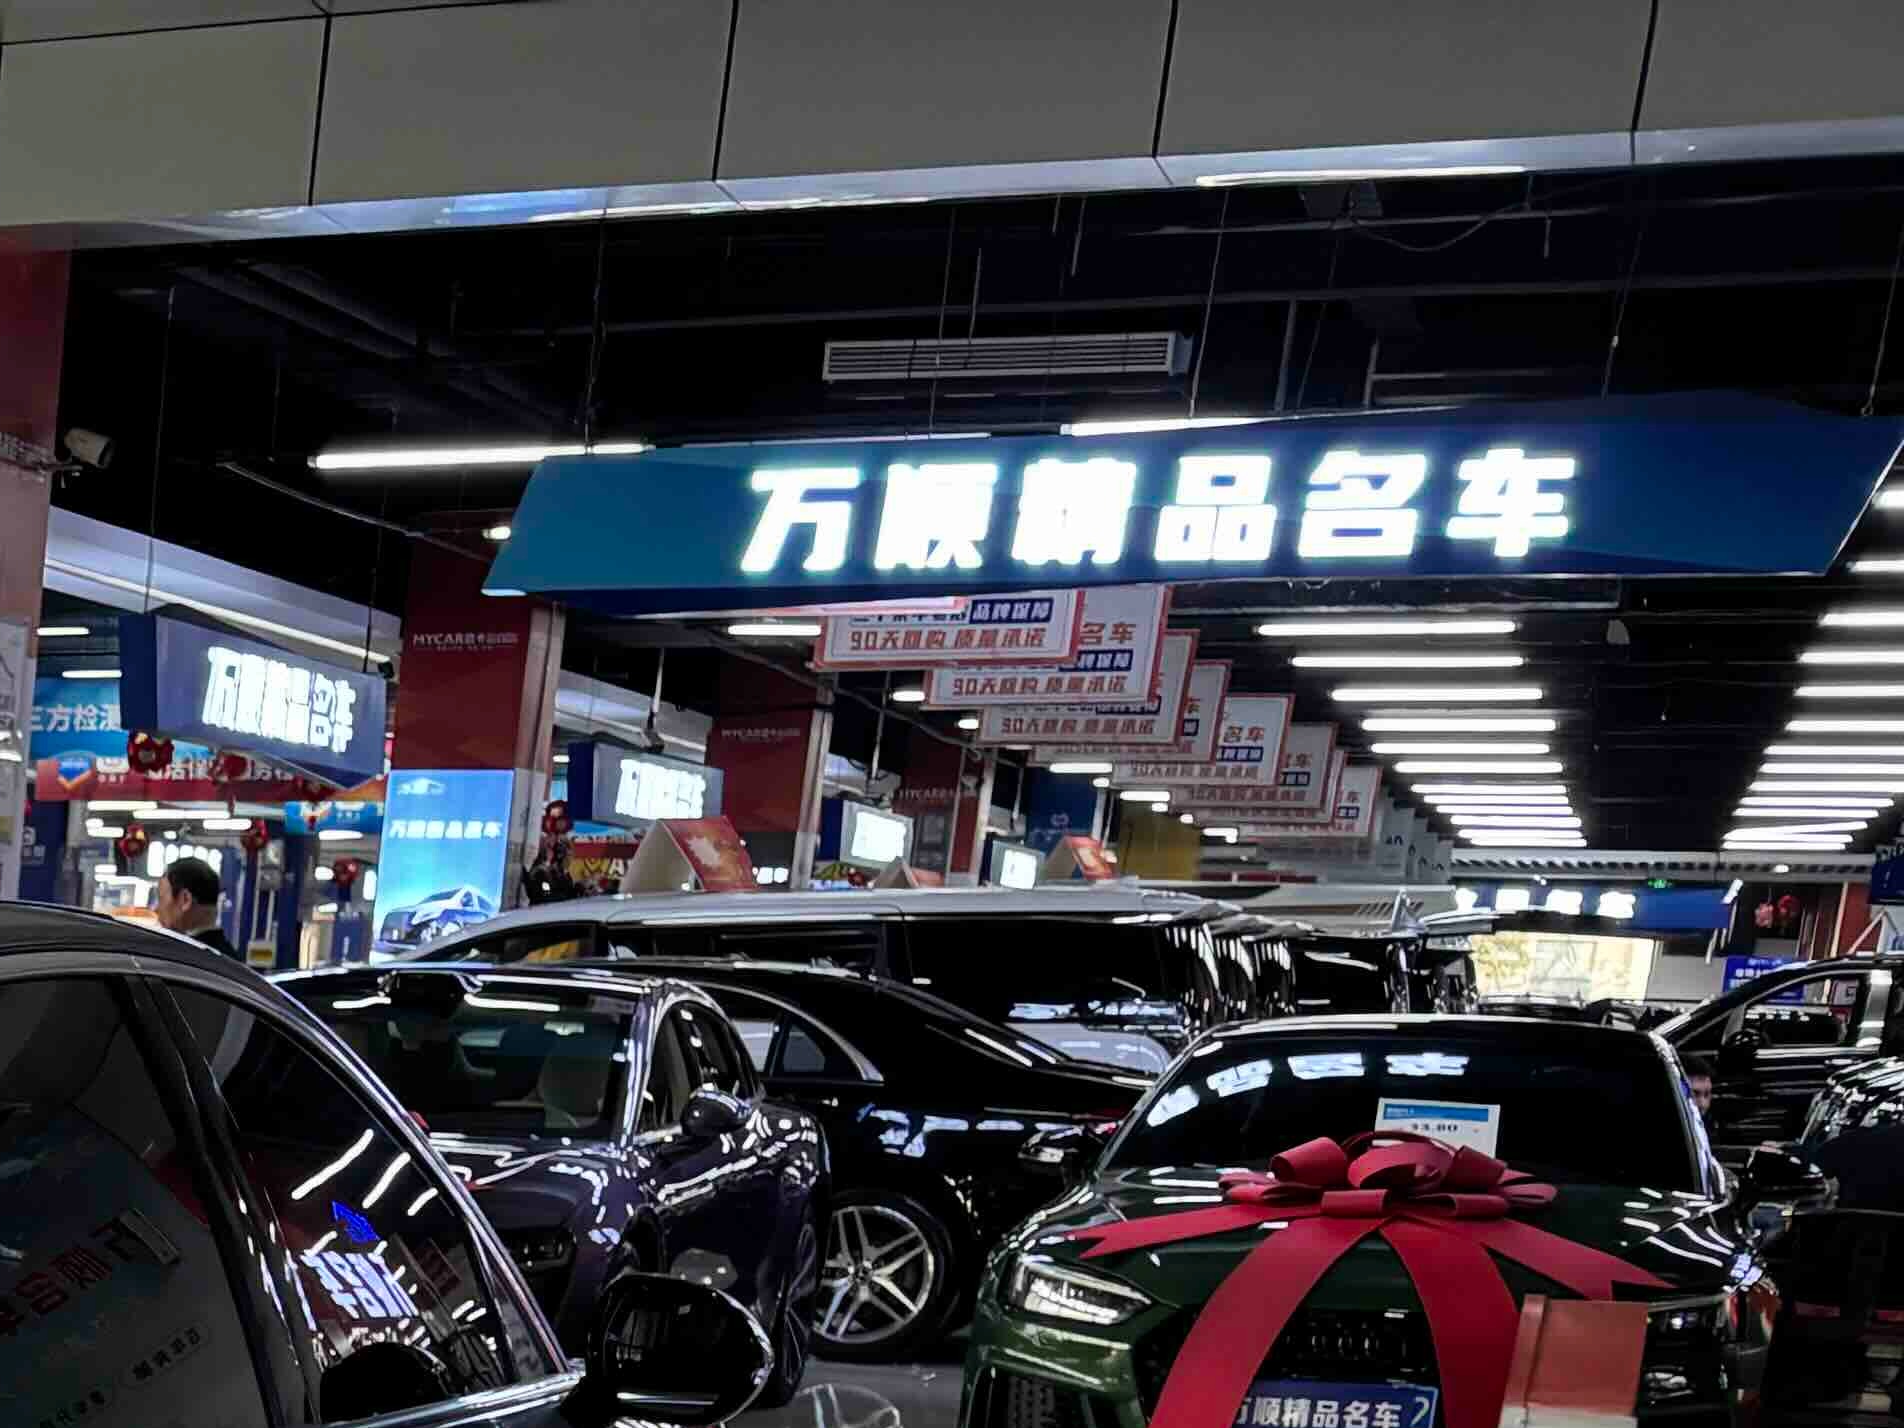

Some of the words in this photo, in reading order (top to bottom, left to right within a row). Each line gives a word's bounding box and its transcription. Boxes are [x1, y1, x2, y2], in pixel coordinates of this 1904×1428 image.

[739, 448, 1577, 573] 万顺精品名车
